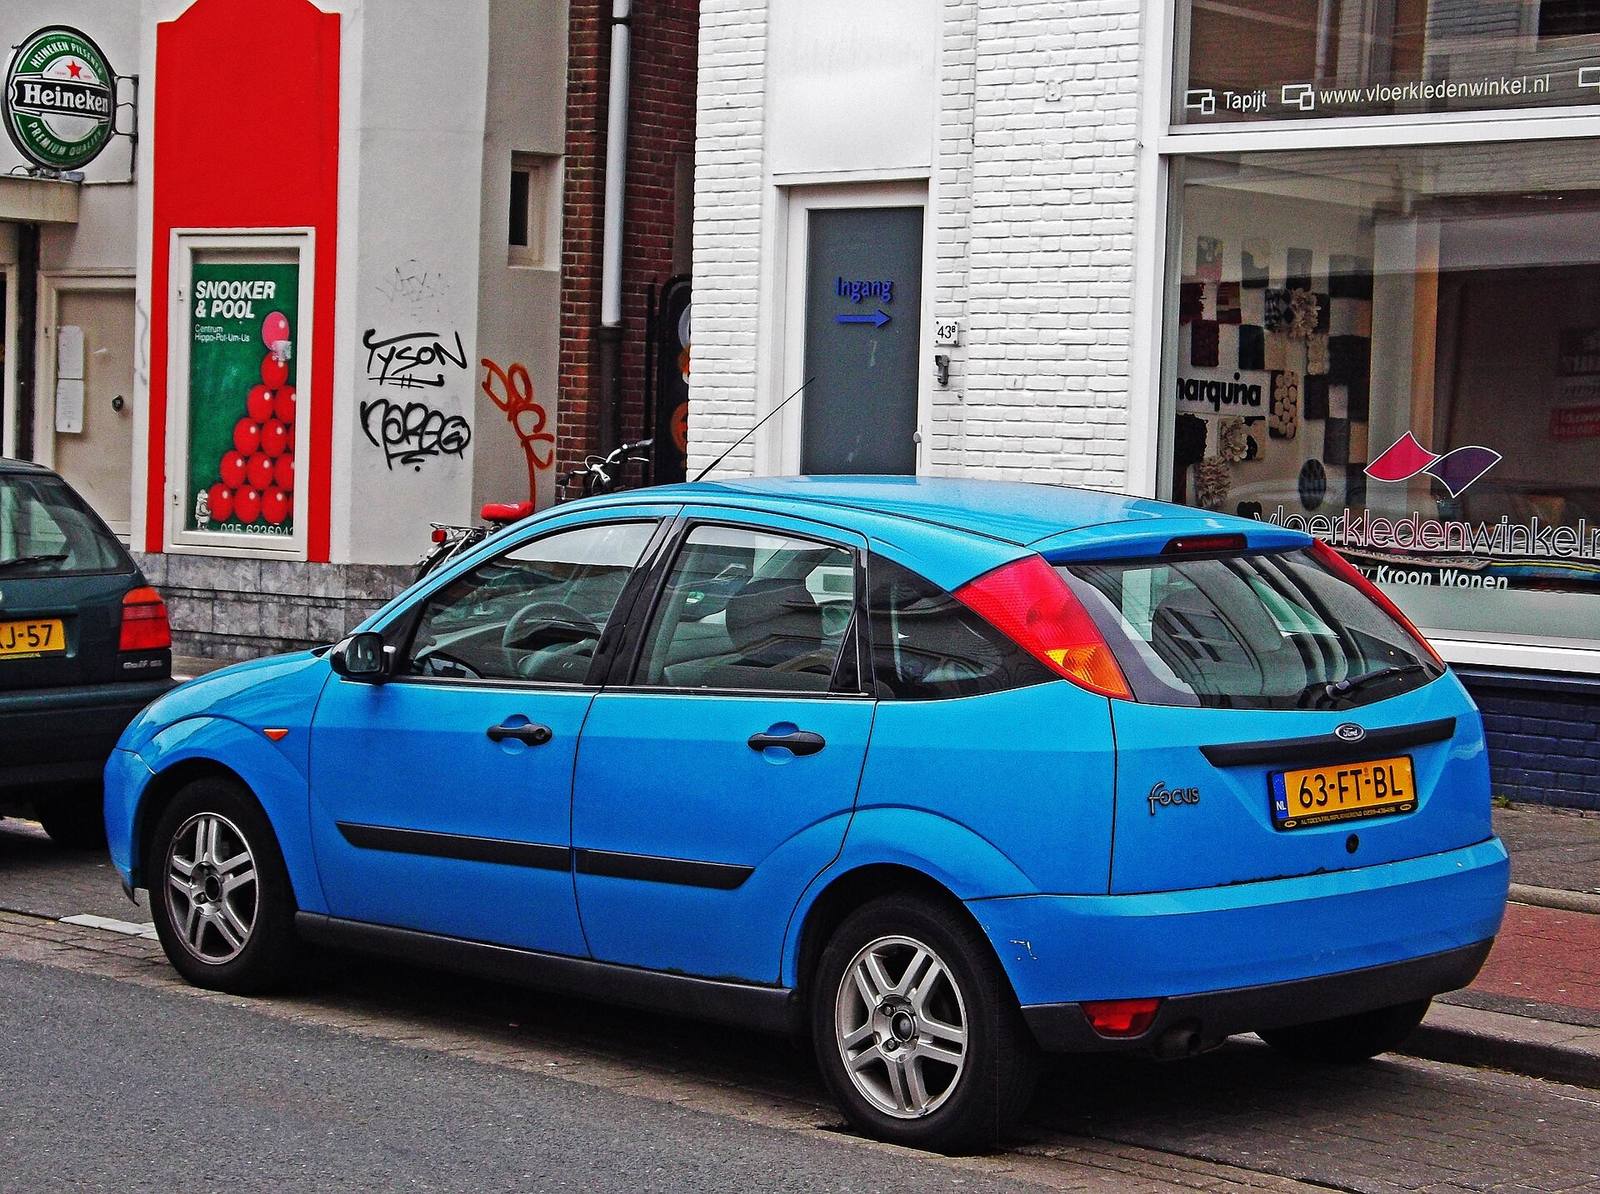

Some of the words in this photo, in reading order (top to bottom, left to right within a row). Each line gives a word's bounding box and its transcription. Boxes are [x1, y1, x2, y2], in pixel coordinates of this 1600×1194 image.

[30, 41, 70, 69] HEINEKEN
[23, 83, 109, 113] Heineken
[1222, 90, 1267, 112] Tapijt
[1320, 74, 1550, 104] www.vloerkledenwinkel.nl
[27, 121, 68, 156] PREMIUM
[195, 280, 276, 300] SNOOKER
[833, 276, 894, 304] Ingang
[195, 299, 207, 318] &
[210, 299, 255, 319] POOL
[194, 323, 223, 333] Centrum
[1376, 565, 1432, 586] Kroon
[1440, 569, 1509, 591] Wonen
[0, 623, 53, 649] J-57
[1299, 765, 1404, 809] 63-FT-BL
[1276, 800, 1287, 812] NL
